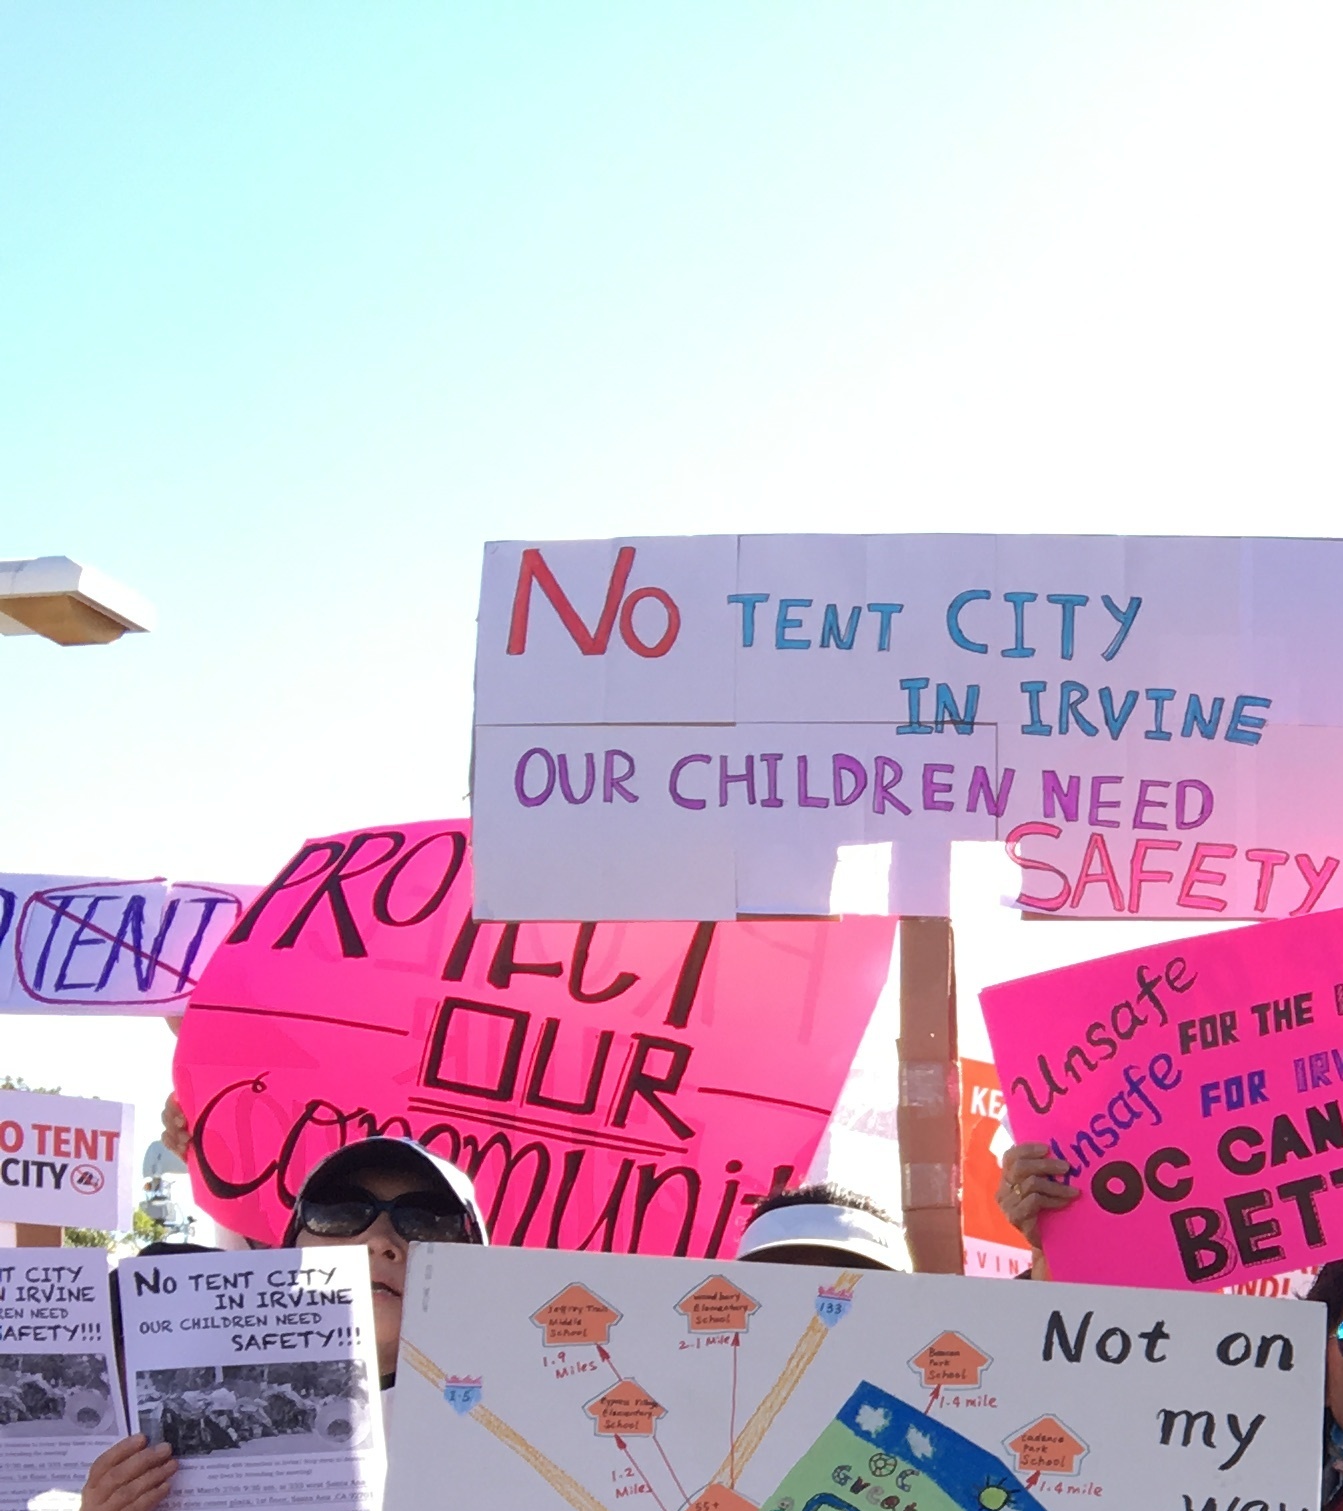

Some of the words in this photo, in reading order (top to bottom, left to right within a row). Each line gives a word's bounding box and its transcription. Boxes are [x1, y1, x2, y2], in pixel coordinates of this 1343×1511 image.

[506, 547, 681, 657] No
[727, 593, 904, 651] TENT
[947, 590, 1142, 661] CITY
[896, 677, 979, 735] IN
[1021, 680, 1271, 745] IRVINE
[515, 747, 638, 807] OUR
[669, 753, 1015, 817] CHILDREN
[1042, 769, 1214, 830] NEED
[1006, 822, 1339, 916] SAFETY
[33, 894, 238, 993] TENT
[1012, 956, 1197, 1114] Unsafe
[1179, 1010, 1238, 1054] FOR
[1251, 992, 1313, 1036] THE
[424, 996, 695, 1139] OUR
[1201, 1070, 1267, 1117] FOR
[0, 1120, 24, 1153] O
[31, 1123, 120, 1162] TENT
[1, 1158, 69, 1189] CITY
[1091, 1146, 1194, 1214] OC
[25, 1266, 83, 1283] CITY
[134, 1267, 176, 1296] No
[189, 1271, 254, 1291] TENT
[267, 1267, 336, 1287] CITY
[16, 1284, 95, 1303] IRVINE
[215, 1293, 245, 1310] IN
[257, 1287, 354, 1309] IRVINE
[31, 1308, 68, 1319] NEED
[696, 1315, 730, 1325] School
[819, 1303, 842, 1315] 133
[139, 1320, 173, 1334] OUR
[180, 1315, 268, 1331] CHILDREN
[276, 1312, 322, 1326] NEED
[549, 1328, 588, 1338] School
[231, 1327, 361, 1351] SAFETY!!!
[1042, 1311, 1169, 1366] Not
[1216, 1331, 1294, 1371] on
[543, 1351, 566, 1367] 1.9
[556, 1360, 598, 1379] Miles
[927, 1369, 966, 1380] School
[939, 1396, 960, 1408] 1.4
[966, 1395, 998, 1408] mile
[603, 1420, 639, 1430] School
[1157, 1407, 1267, 1471] my
[1021, 1455, 1065, 1467] School
[612, 1468, 634, 1481] 1.2
[615, 1483, 652, 1498] Miles
[1039, 1482, 1063, 1494] 1.4
[1067, 1484, 1103, 1497] mile
